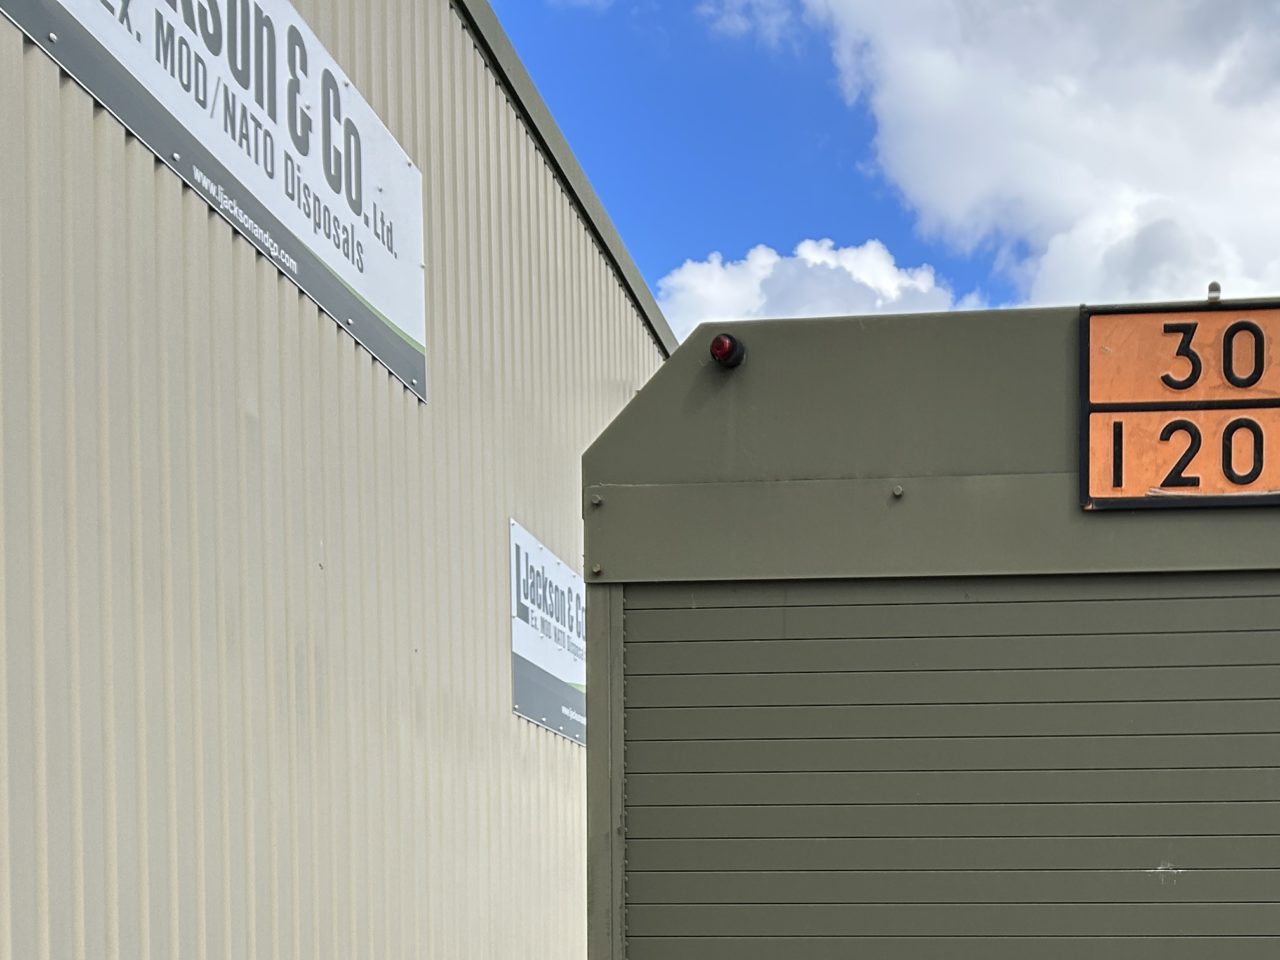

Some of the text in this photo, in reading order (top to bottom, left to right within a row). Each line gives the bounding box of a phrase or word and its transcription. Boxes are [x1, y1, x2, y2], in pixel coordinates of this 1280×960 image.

[155, 7, 275, 180] MOD/NATO
[284, 150, 364, 273] Disposals
[287, 24, 312, 157] &
[321, 67, 369, 228] Co.
[372, 201, 398, 260] Ltd.
[1160, 320, 1265, 391] 30
[567, 586, 575, 632] &
